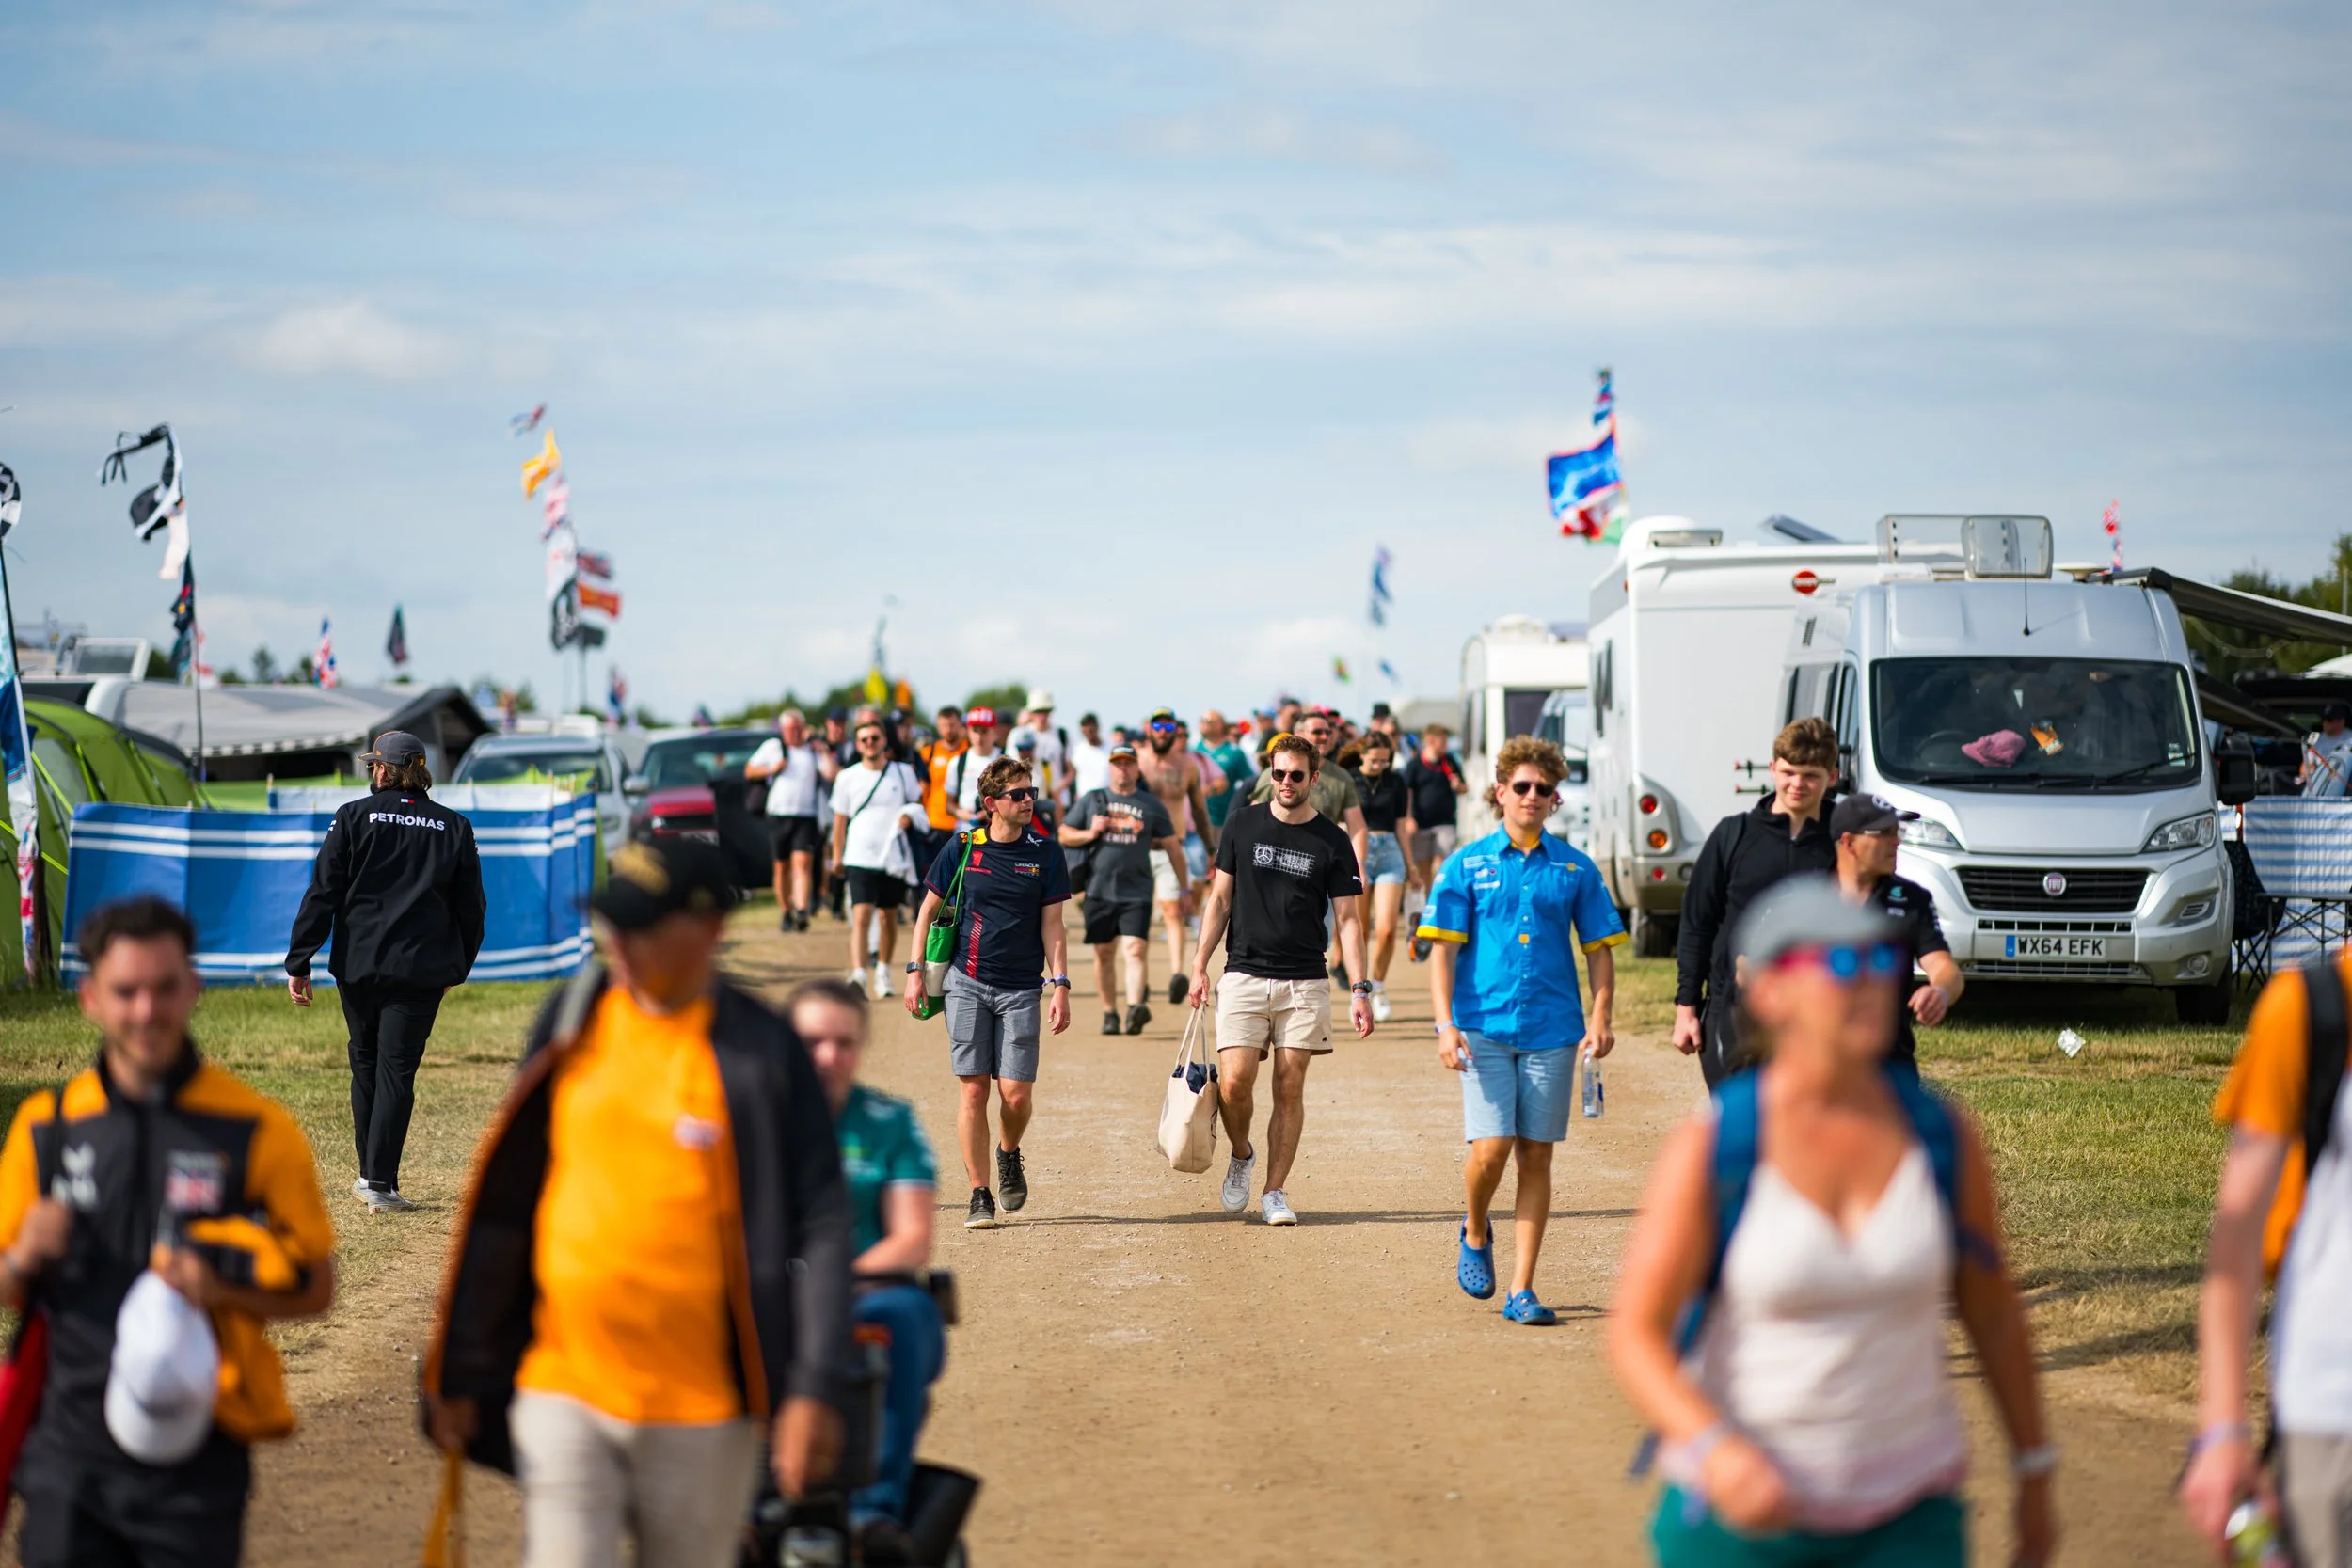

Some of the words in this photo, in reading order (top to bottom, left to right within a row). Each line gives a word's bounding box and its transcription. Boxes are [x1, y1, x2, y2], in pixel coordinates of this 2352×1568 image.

[369, 813, 445, 831] PETRONAS
[2018, 939, 2063, 955] WX64
[2069, 940, 2103, 956] EFK
